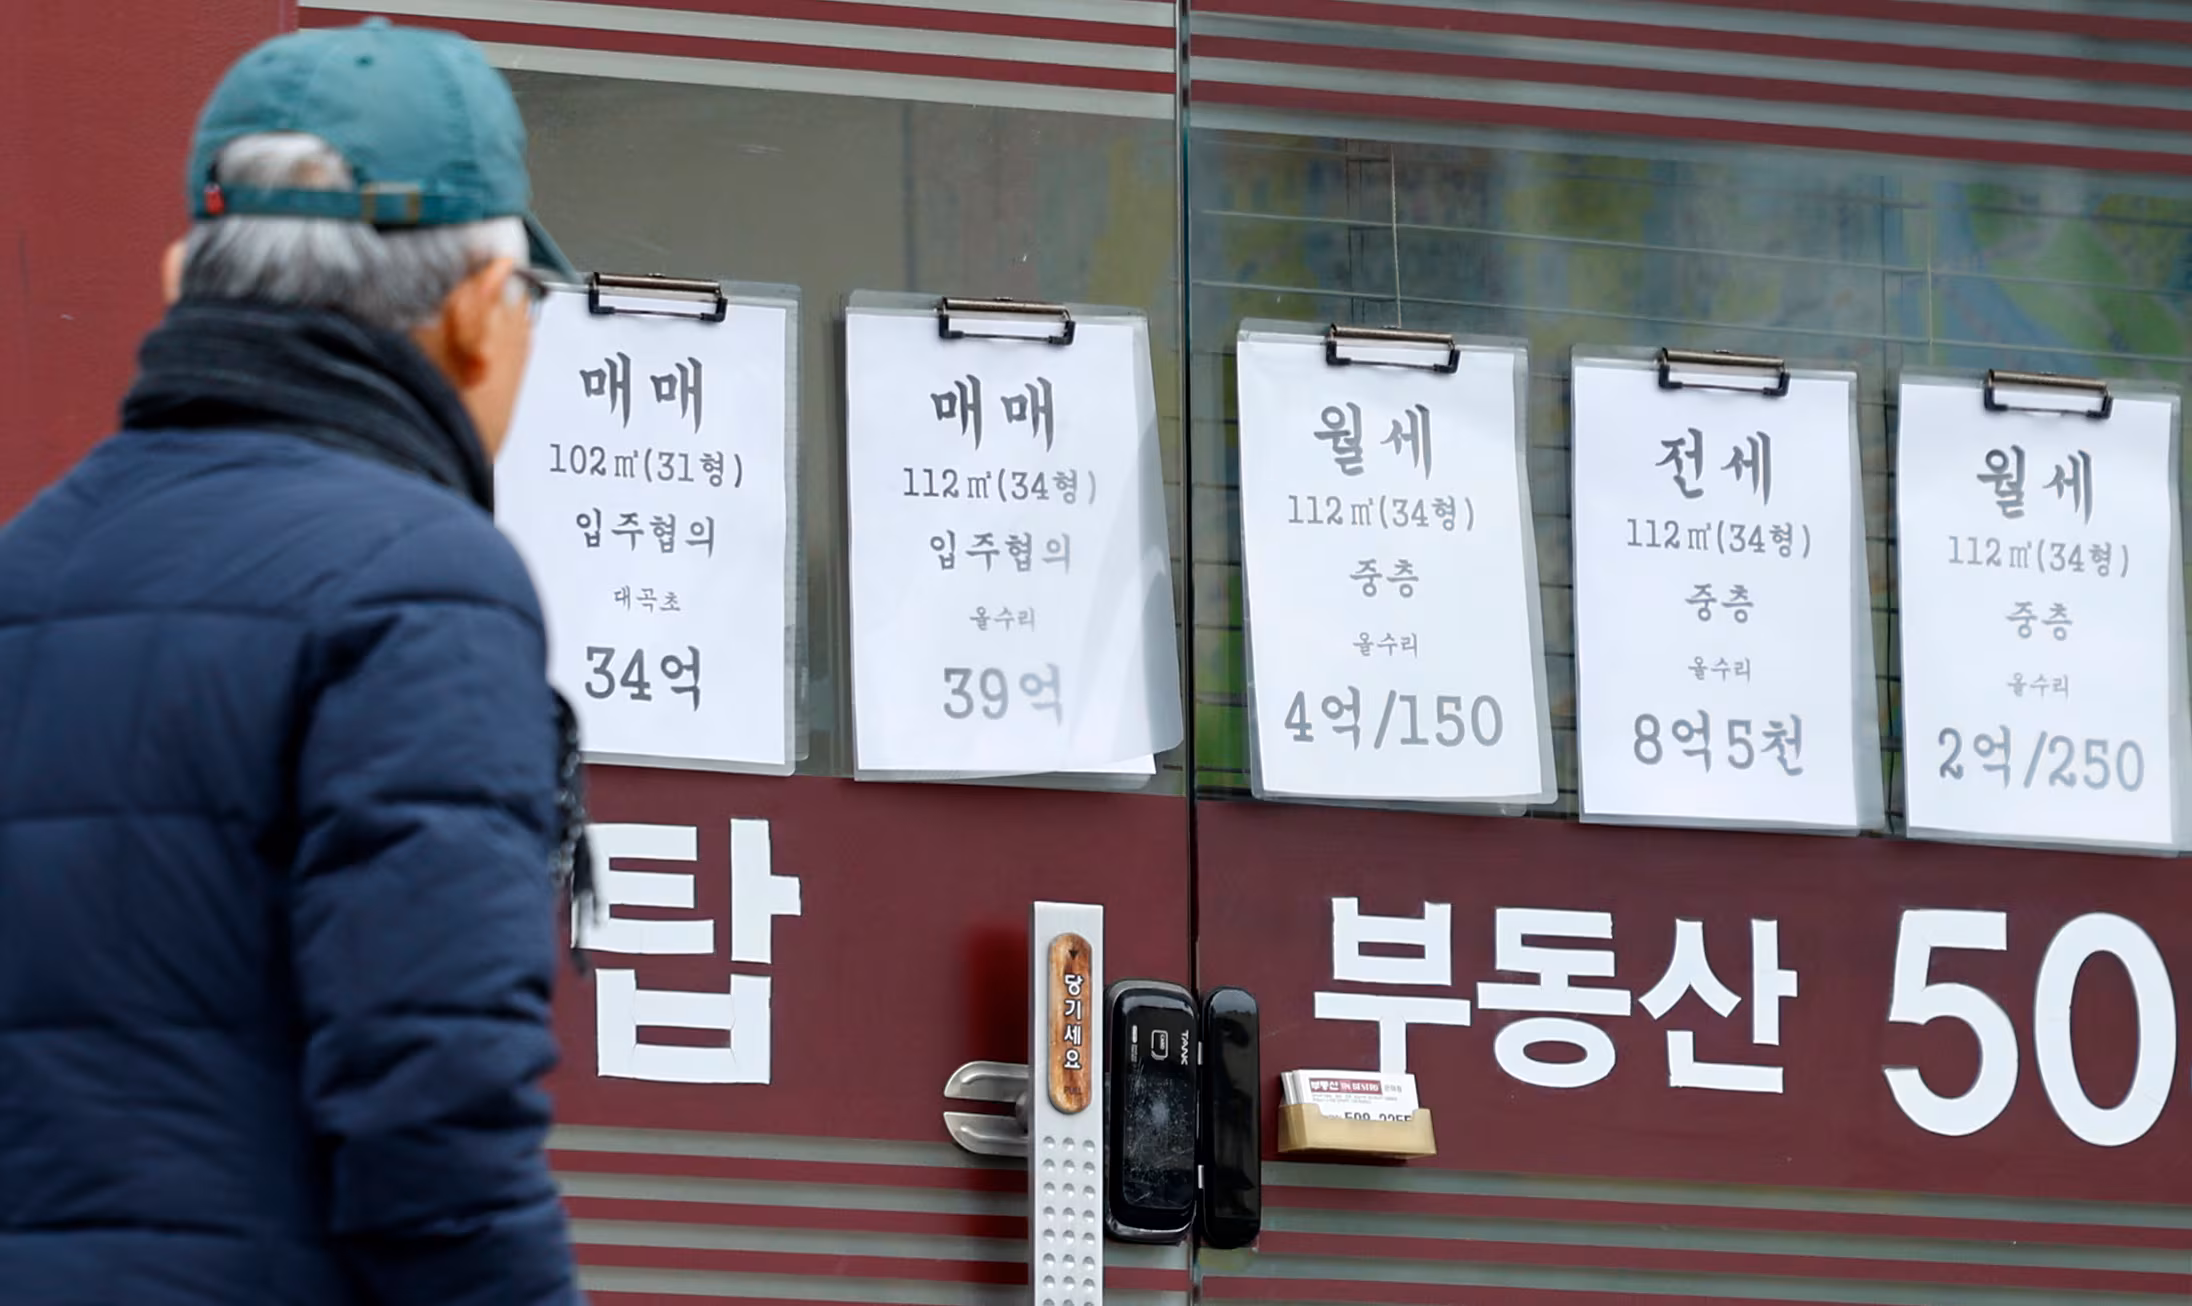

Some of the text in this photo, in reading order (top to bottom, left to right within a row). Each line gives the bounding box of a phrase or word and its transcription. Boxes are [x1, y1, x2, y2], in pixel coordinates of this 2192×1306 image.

[579, 351, 703, 434] 매매
[930, 373, 1054, 453] 매매
[1313, 399, 1432, 480] 월세
[1654, 427, 1771, 507] 전세
[1976, 444, 2093, 525] 월세
[576, 507, 715, 557] 입주협의
[930, 529, 1070, 573] 입주협의
[613, 585, 681, 613] 대곡초
[1349, 558, 1419, 598] 중층
[1684, 583, 1755, 624] 중층
[969, 606, 1036, 631] 올수리
[1352, 632, 1417, 658] 올수리
[2005, 601, 2073, 641] 중층
[584, 645, 701, 712] 34억
[943, 664, 1062, 723] 39억
[1688, 656, 1750, 683] 올수리
[2008, 672, 2068, 698] 올수리
[1284, 685, 1503, 751] 4억/150
[1938, 725, 2144, 792] 2억/250
[568, 818, 802, 1085] 탑
[1313, 897, 1799, 1094] 부동산
[1063, 973, 1083, 1070] 당기세요
[1180, 1028, 1190, 1066] TANK
